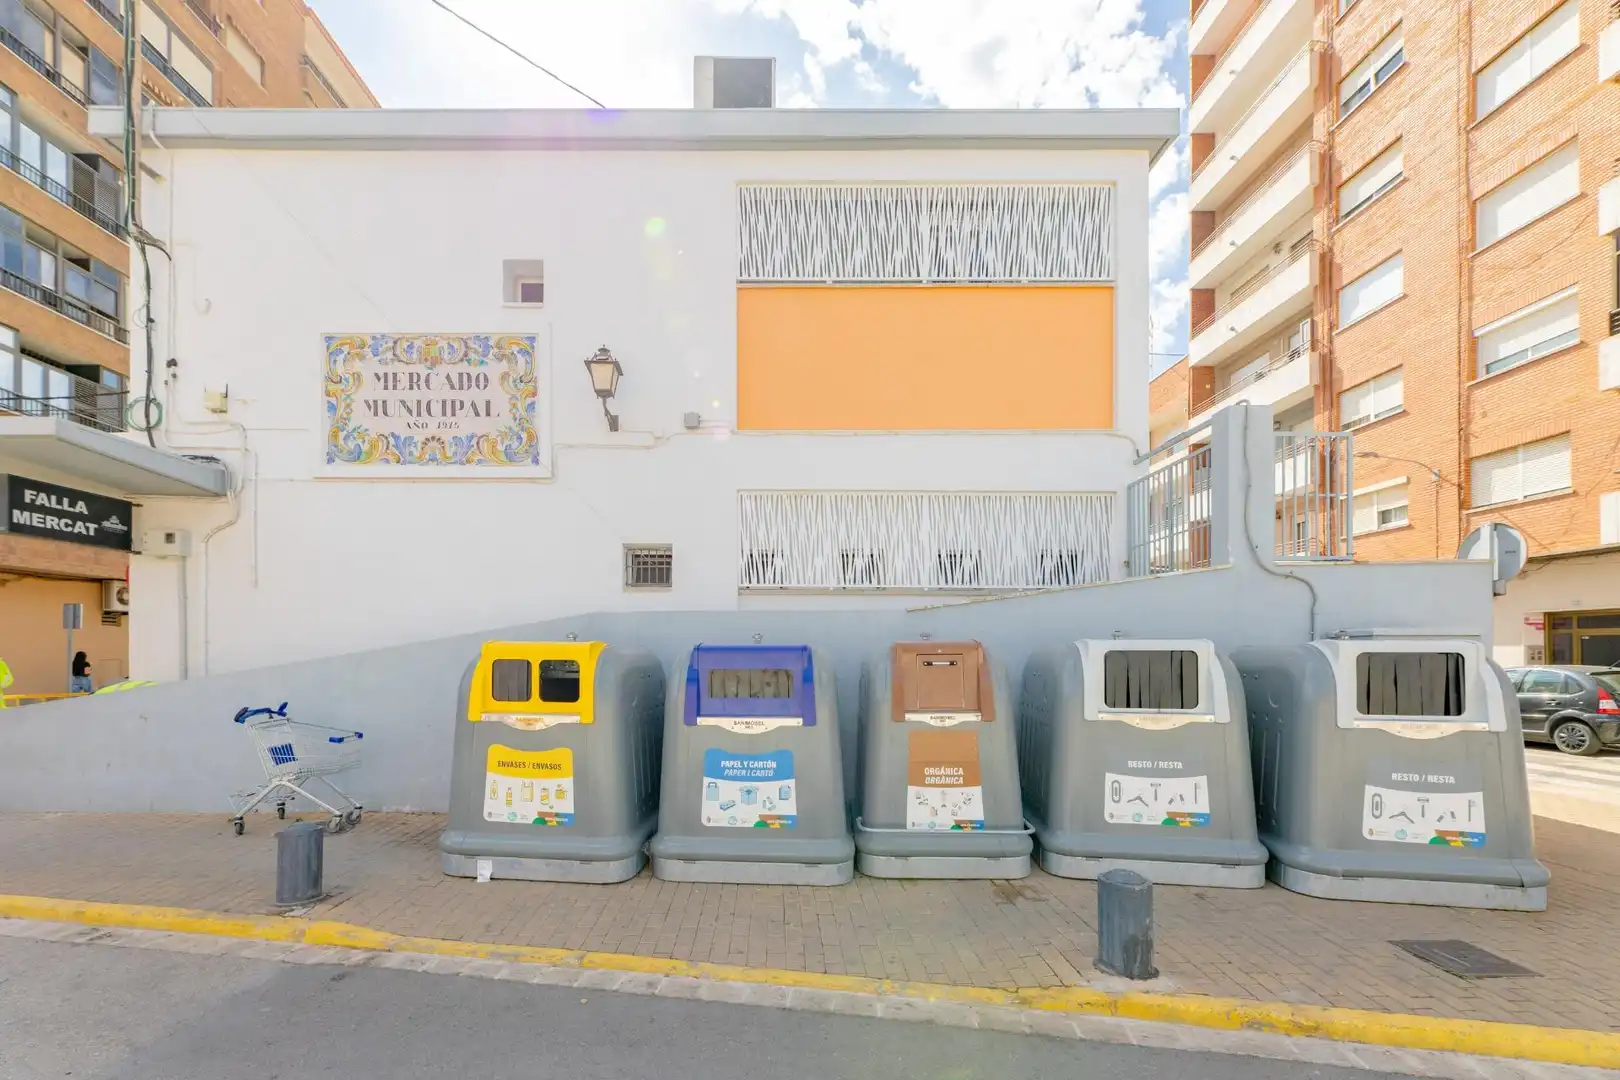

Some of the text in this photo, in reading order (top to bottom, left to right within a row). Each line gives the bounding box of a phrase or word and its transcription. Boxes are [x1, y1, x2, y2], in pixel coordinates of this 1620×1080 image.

[373, 372, 489, 391] MERCADO
[363, 398, 500, 417] MUNICIPAL
[405, 419, 429, 430] AÑO
[24, 489, 88, 514] FALLA
[12, 509, 98, 536] MERCAT
[498, 760, 527, 769] ENVASES
[720, 759, 777, 769] PAPEL Y CARTÓN
[1128, 760, 1152, 768] RESTO
[724, 769, 747, 777] PAPER
[924, 766, 964, 775] ORGÁNICA
[1391, 773, 1420, 782] RESTO
[1427, 775, 1455, 784] RESTA
